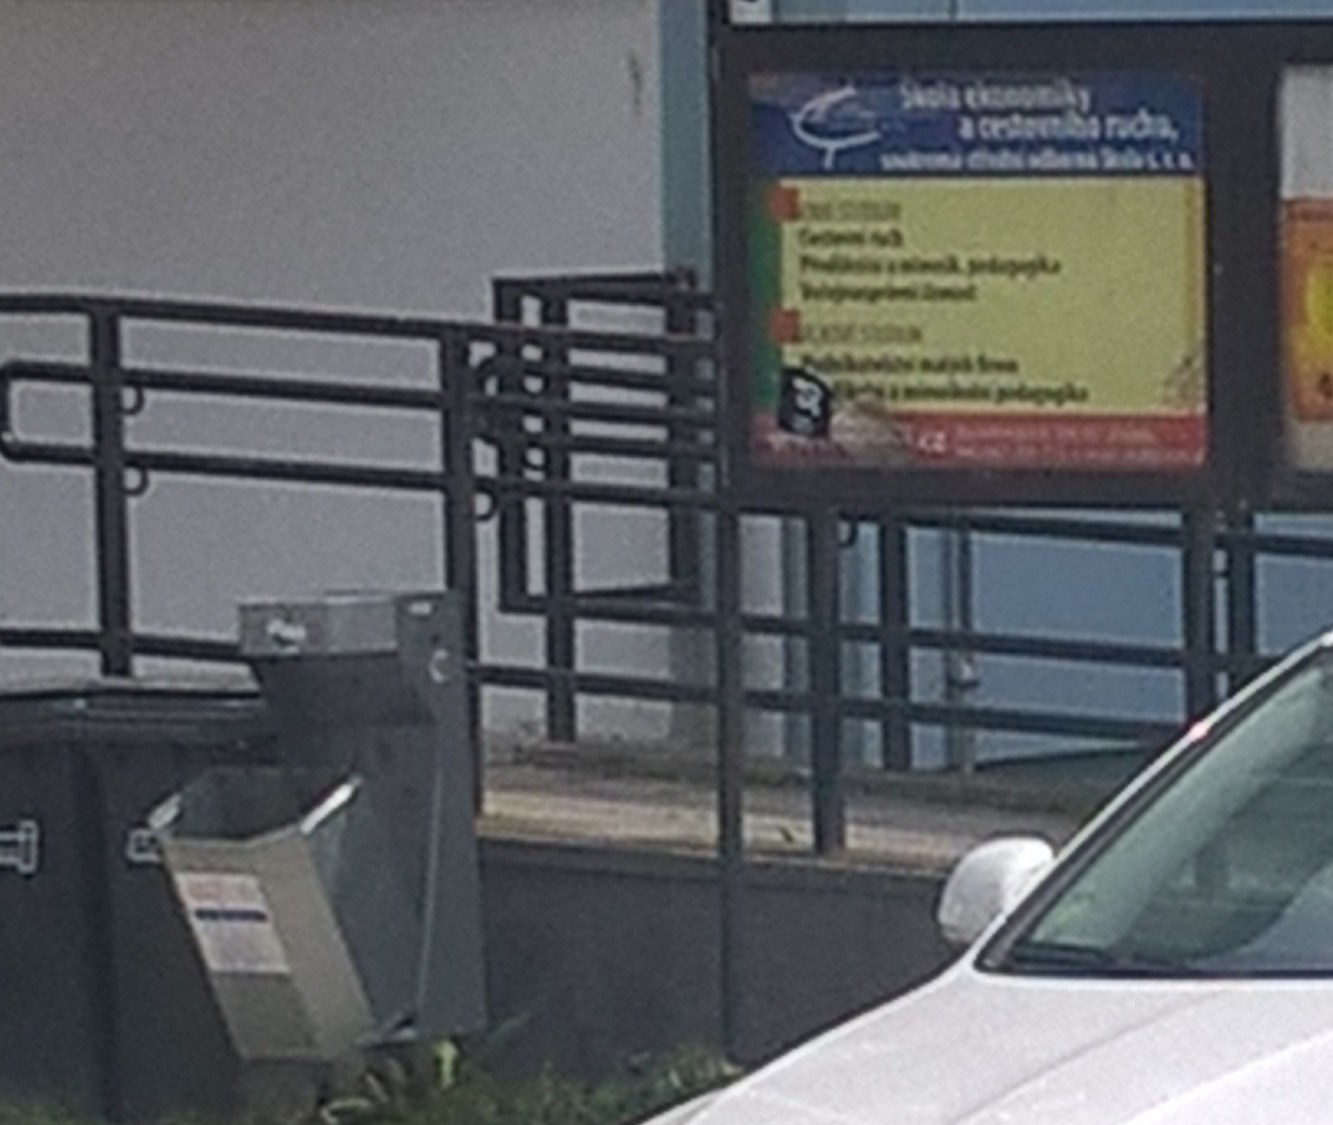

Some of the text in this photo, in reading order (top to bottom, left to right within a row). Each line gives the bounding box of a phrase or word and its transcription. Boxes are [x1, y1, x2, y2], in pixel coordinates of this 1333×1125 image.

[900, 77, 1091, 113] Škola ekonomiky
[958, 116, 975, 139] a
[978, 110, 1100, 139] cestovního
